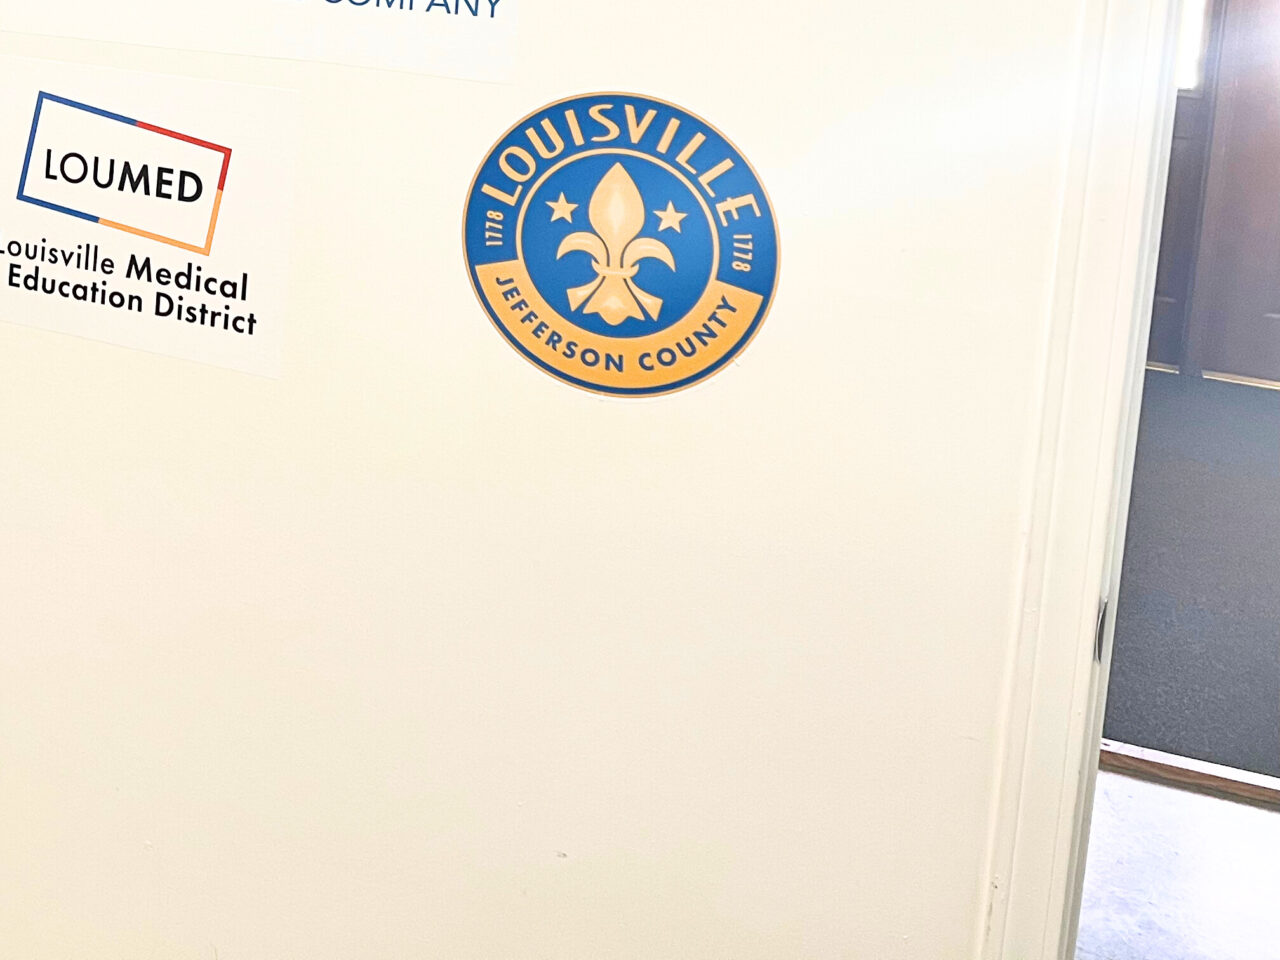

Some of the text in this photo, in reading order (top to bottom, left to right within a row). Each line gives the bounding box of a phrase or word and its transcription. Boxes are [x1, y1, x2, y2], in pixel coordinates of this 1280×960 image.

[45, 148, 203, 203] LOUMED
[480, 103, 762, 227] LOUISVILLE
[485, 209, 505, 247] 1778
[732, 233, 753, 272] 1778
[8, 263, 143, 312] Education
[154, 291, 257, 335] District
[126, 254, 248, 301] Medical
[496, 276, 738, 373] JEFFERSON COUNTY
